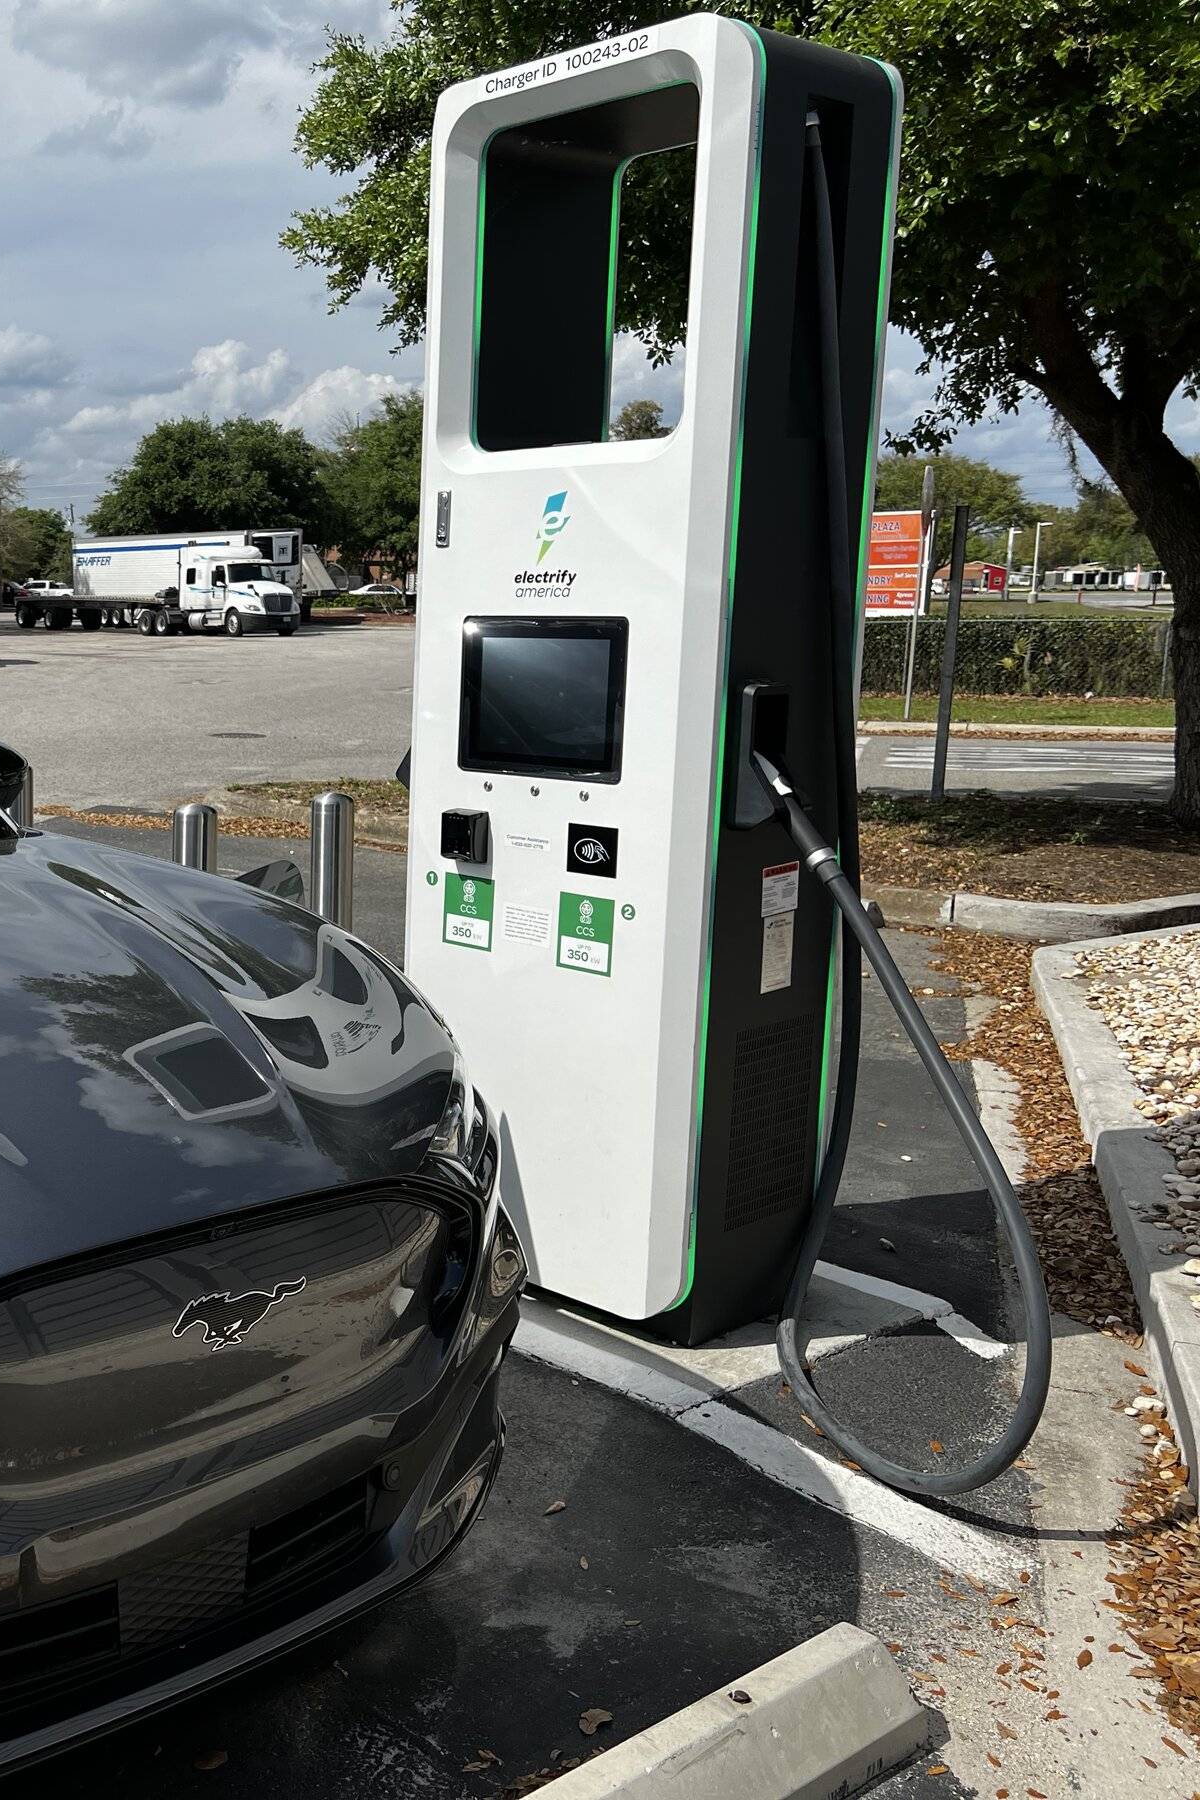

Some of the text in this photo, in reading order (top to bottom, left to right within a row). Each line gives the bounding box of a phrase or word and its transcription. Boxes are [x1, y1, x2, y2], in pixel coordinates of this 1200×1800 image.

[485, 35, 649, 94] Charger ID 100243-02
[872, 522, 900, 531] PLAZA
[76, 556, 112, 567] SHAFFER
[514, 569, 577, 586] electrify
[868, 576, 892, 585] NDRY
[515, 585, 571, 598] america
[867, 594, 889, 603] NING
[460, 904, 477, 915] CCS
[452, 926, 472, 938] 350
[576, 926, 595, 937] CCS
[567, 949, 589, 962] 350
